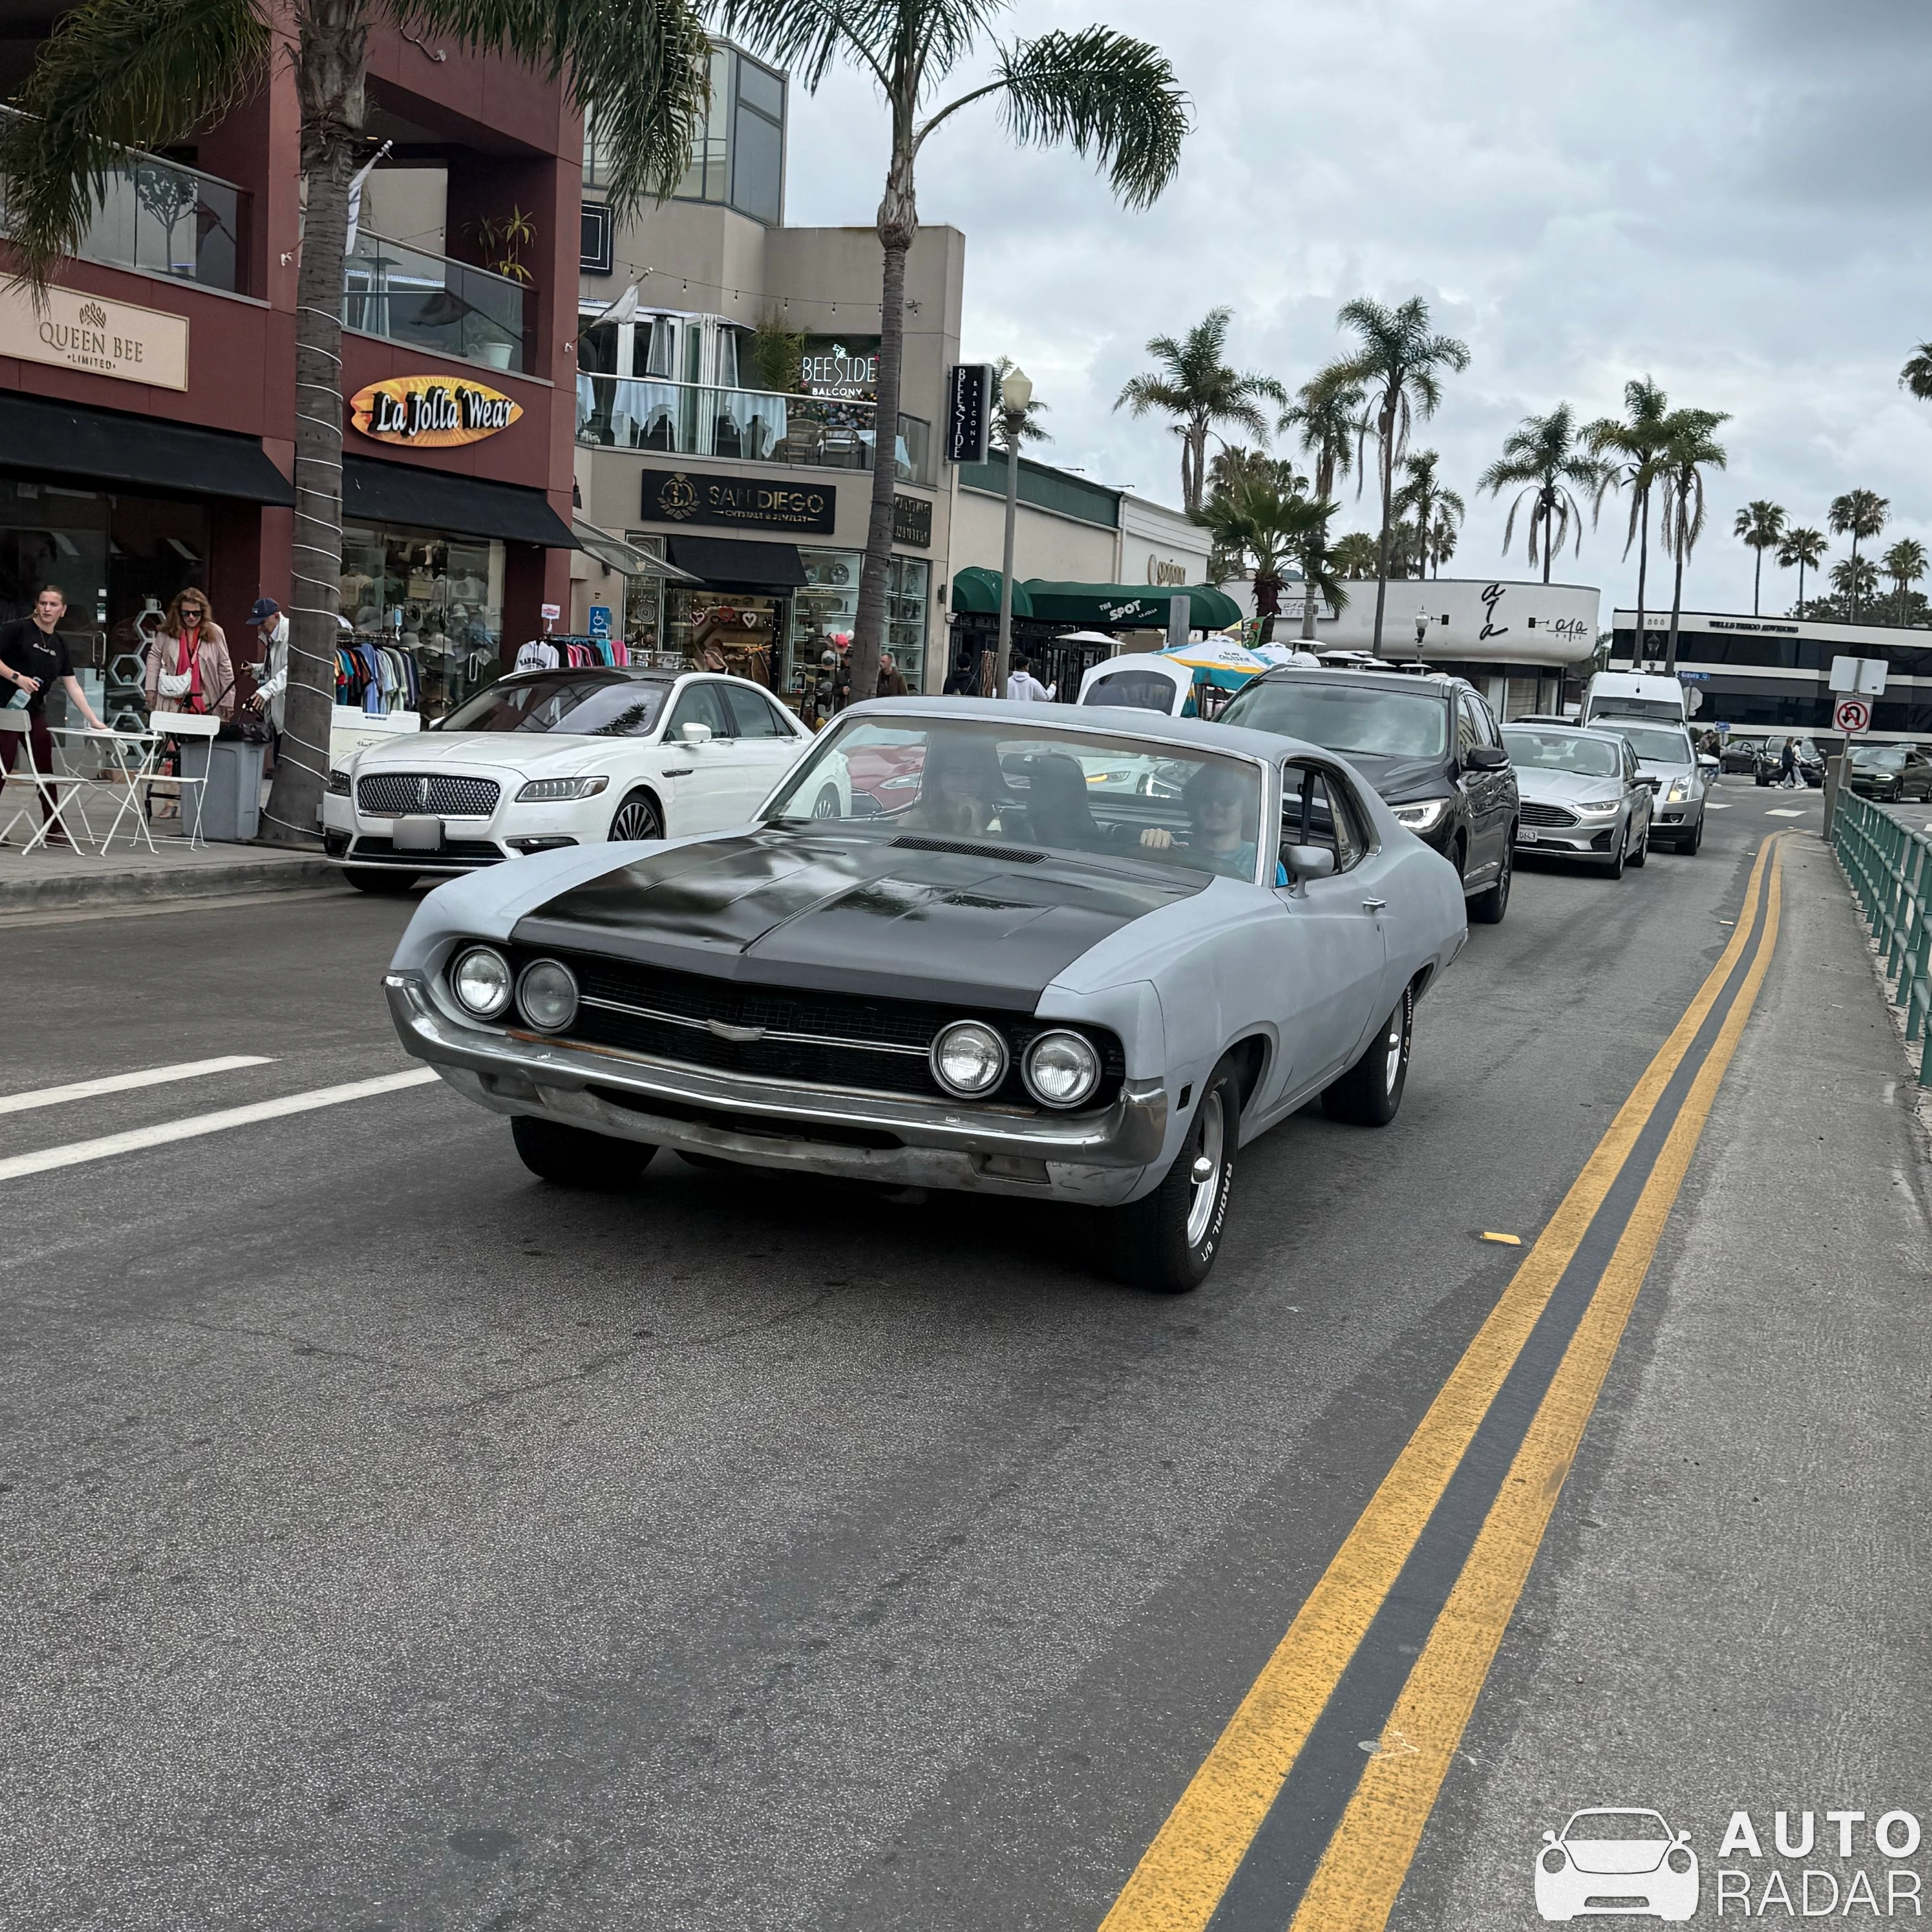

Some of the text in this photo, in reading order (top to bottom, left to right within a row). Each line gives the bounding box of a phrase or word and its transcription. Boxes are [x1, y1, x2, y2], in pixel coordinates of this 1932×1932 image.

[39, 322, 143, 363] QUEEN BEE
[72, 353, 112, 369] LIMITED
[802, 356, 878, 386] BEESIDE
[812, 387, 863, 396] BALCONY
[374, 388, 515, 437] La Jolla Wear
[954, 368, 966, 459] BEESIDE
[970, 380, 978, 445] BALCONY
[757, 490, 825, 514] DIEGO
[1109, 599, 1141, 621] SPOT
[1212, 1162, 1233, 1235] RADIAL
